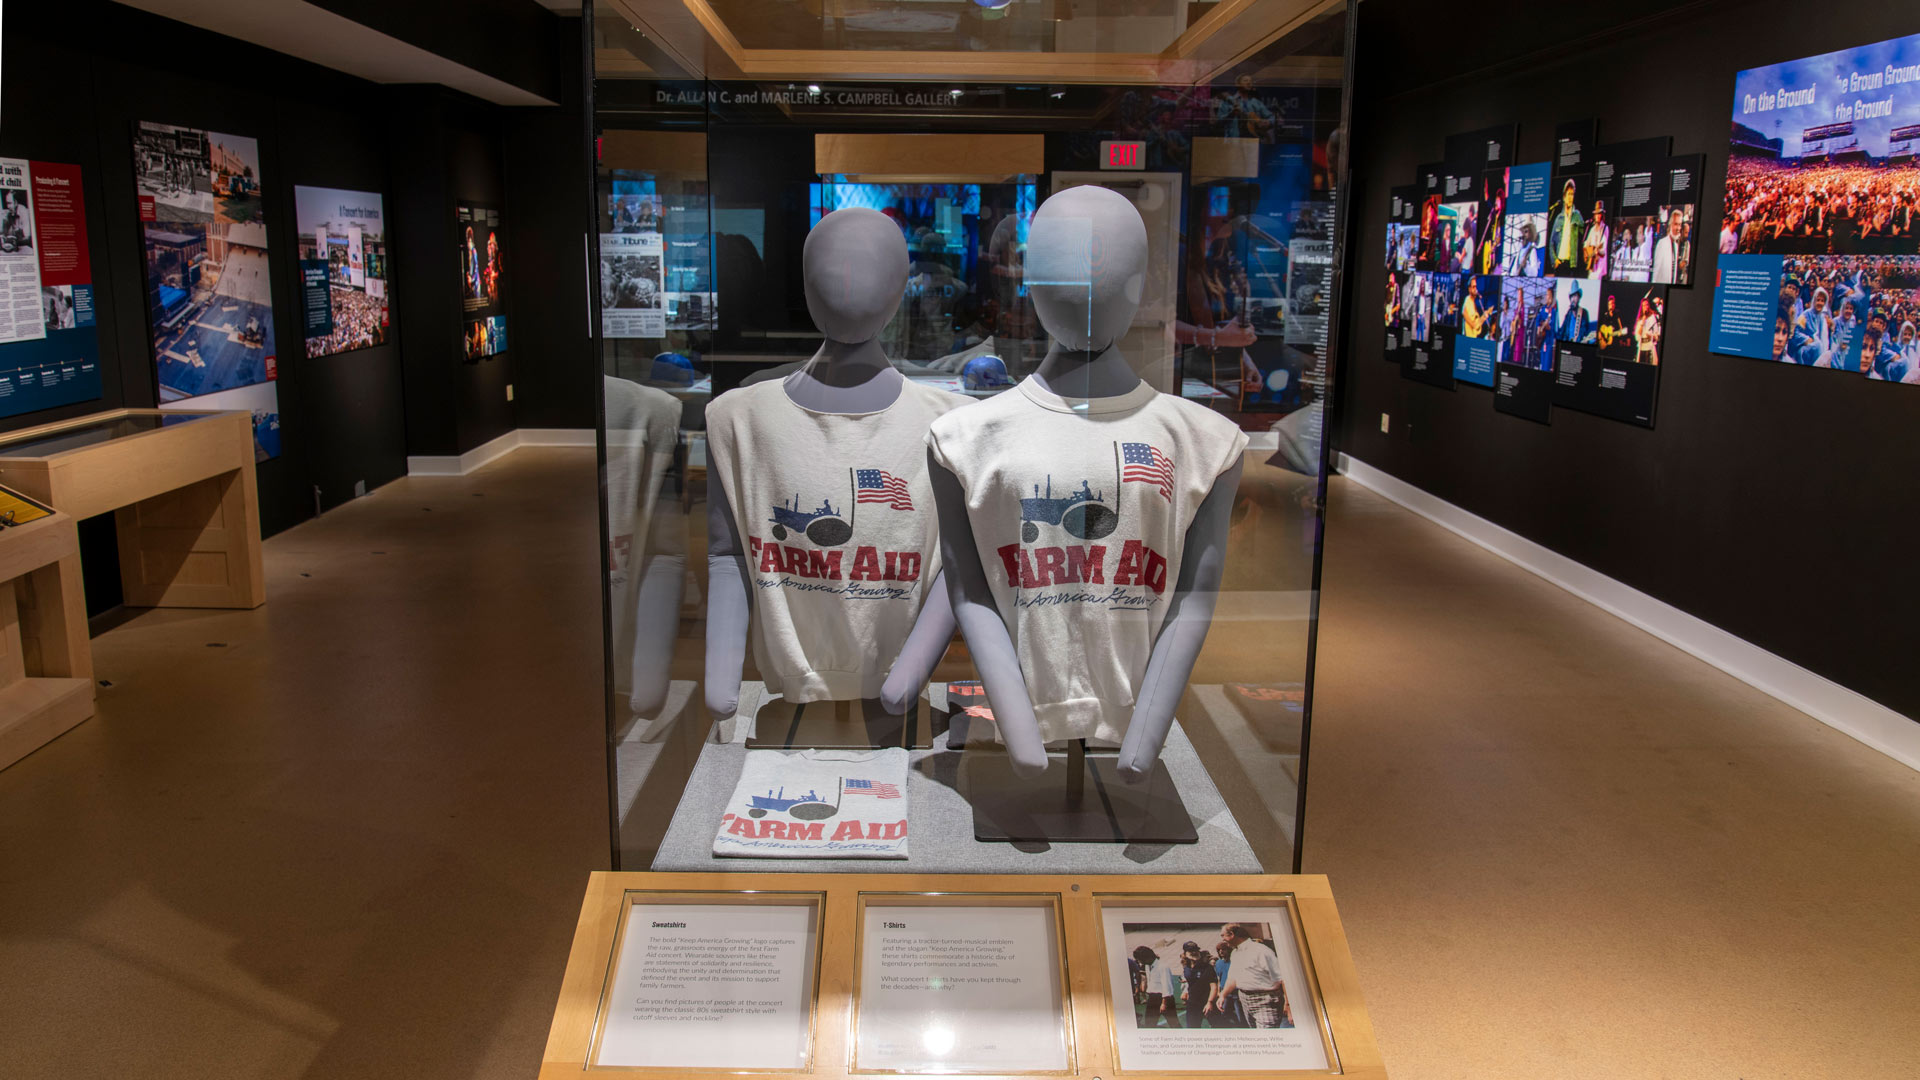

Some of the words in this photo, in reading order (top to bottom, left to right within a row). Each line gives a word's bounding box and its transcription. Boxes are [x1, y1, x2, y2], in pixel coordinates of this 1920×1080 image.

[656, 91, 673, 102] Dr.
[677, 91, 716, 103] ALLAN
[720, 91, 731, 103] C.
[735, 91, 757, 103] and
[762, 92, 820, 104] MARLENE
[823, 91, 834, 104] S.
[837, 92, 900, 105] CAMPBELL
[1743, 94, 1756, 114] On
[1758, 91, 1775, 111] the
[1777, 83, 1816, 109] Ground
[1835, 103, 1853, 121] the
[1854, 94, 1894, 120] Ground
[1110, 144, 1139, 166] EXIT
[5, 167, 22, 176] with
[849, 546, 922, 582] AID
[1113, 540, 1167, 595] AD
[776, 576, 841, 594] America
[840, 580, 920, 600] Growing!
[1027, 591, 1103, 608] America
[830, 819, 908, 842] AID
[652, 921, 687, 929] Sweatshirts
